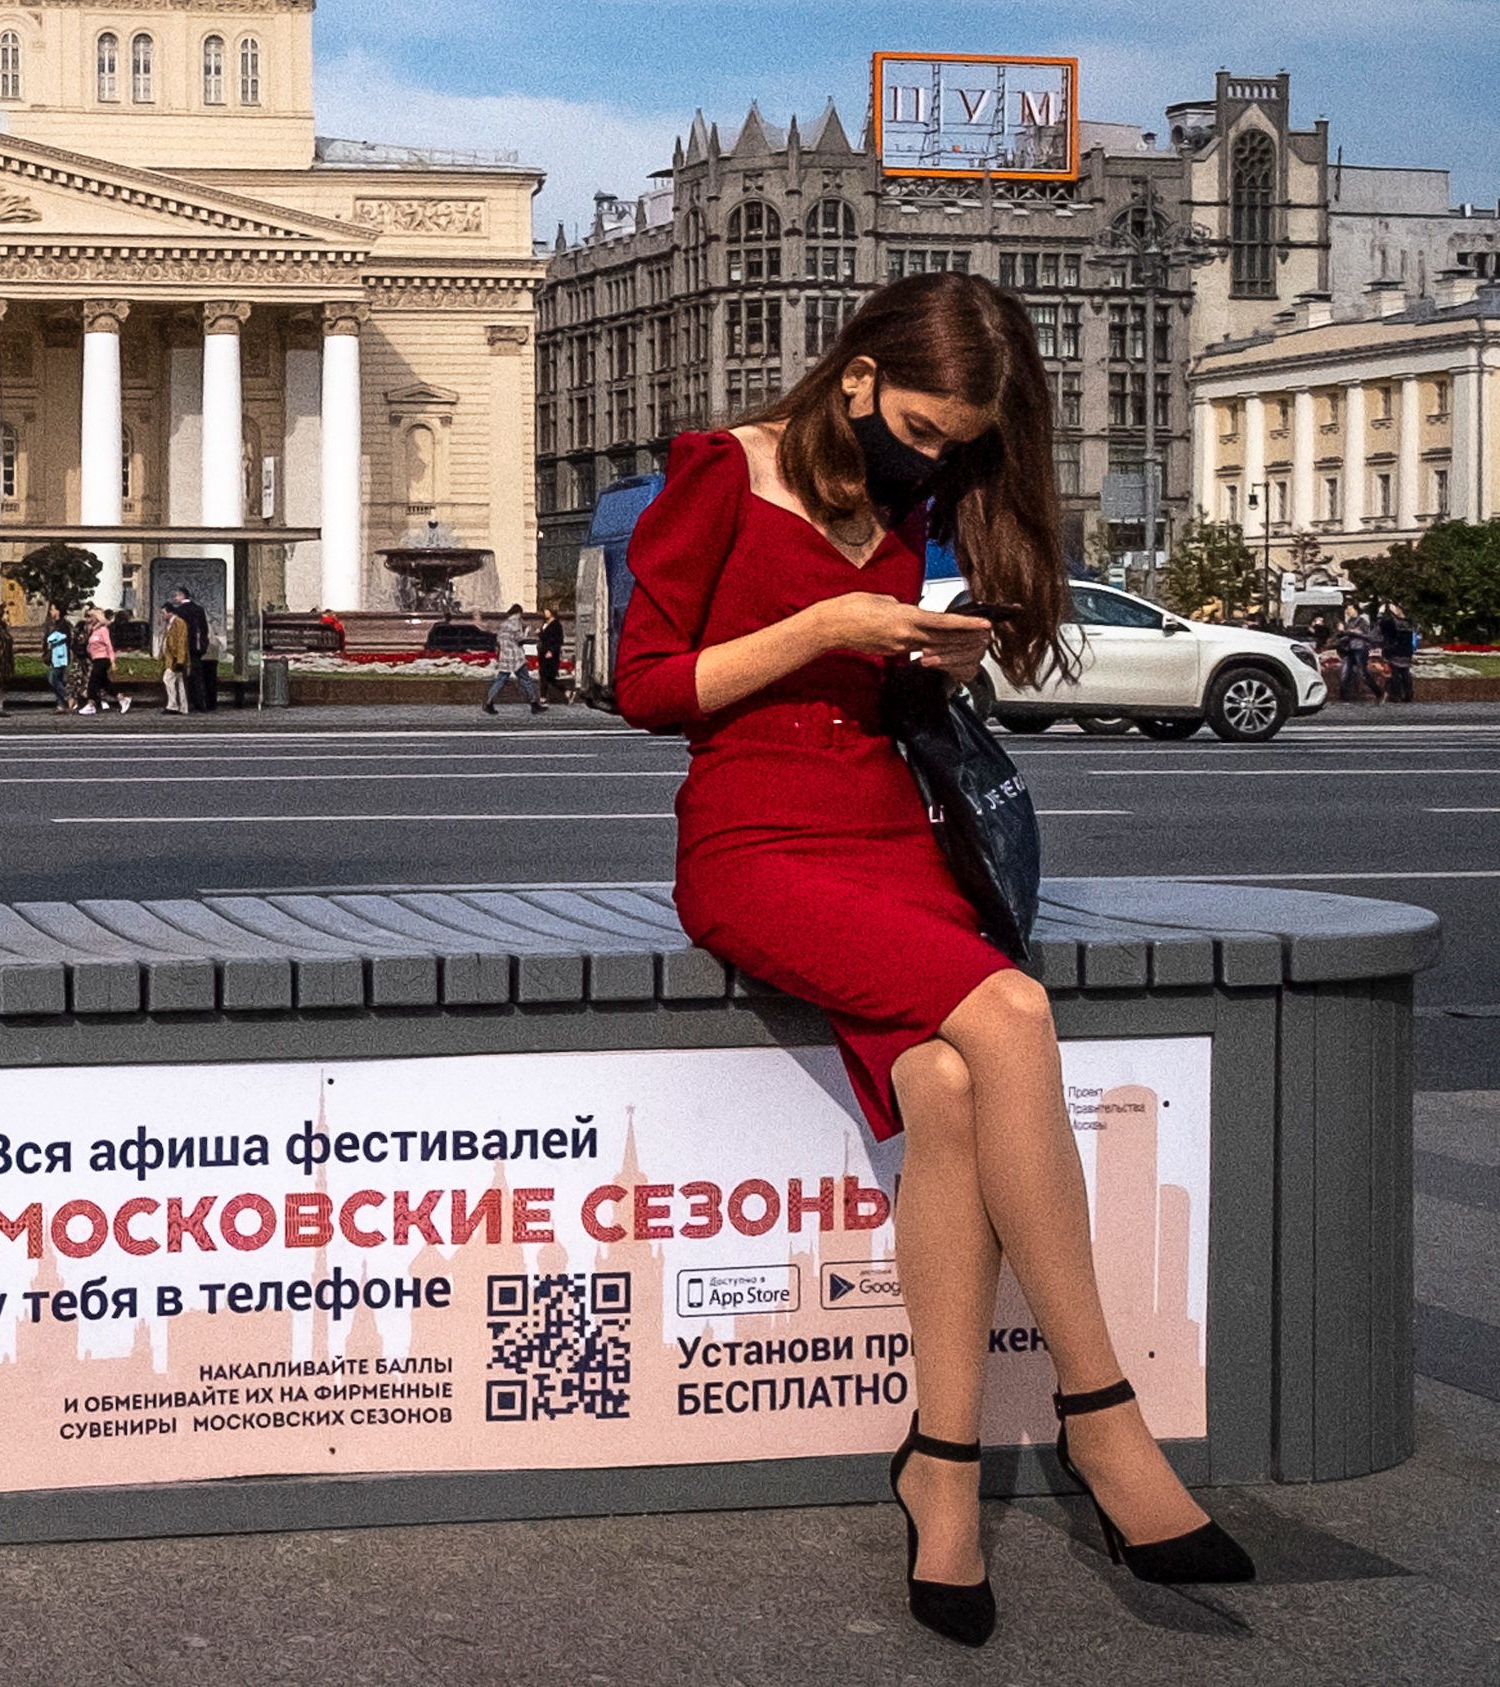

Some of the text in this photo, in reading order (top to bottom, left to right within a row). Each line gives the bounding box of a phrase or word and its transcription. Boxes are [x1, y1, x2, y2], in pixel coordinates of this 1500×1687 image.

[90, 1126, 270, 1182] афиша
[287, 1119, 598, 1177] фестивалей
[23, 1276, 139, 1324] тебя
[157, 1287, 184, 1318] в
[200, 1267, 453, 1322] телефоне
[709, 1276, 757, 1288] Доступно
[709, 1286, 790, 1307] App Store
[859, 1278, 900, 1295] Goog
[200, 1355, 452, 1381] НАКАПЛИВАЙТЕ БАЛЛЫ
[677, 1335, 853, 1369] Установи
[64, 1382, 453, 1413] И ОБМЕНИВАЙТЕ ИХ НА ФИРМЕННЫЕ
[678, 1371, 908, 1415] БЕСПЛАТНО
[60, 1406, 452, 1440] СУВЕНИРЫ МОСКОВСКИХ СЕЗОНОВ
